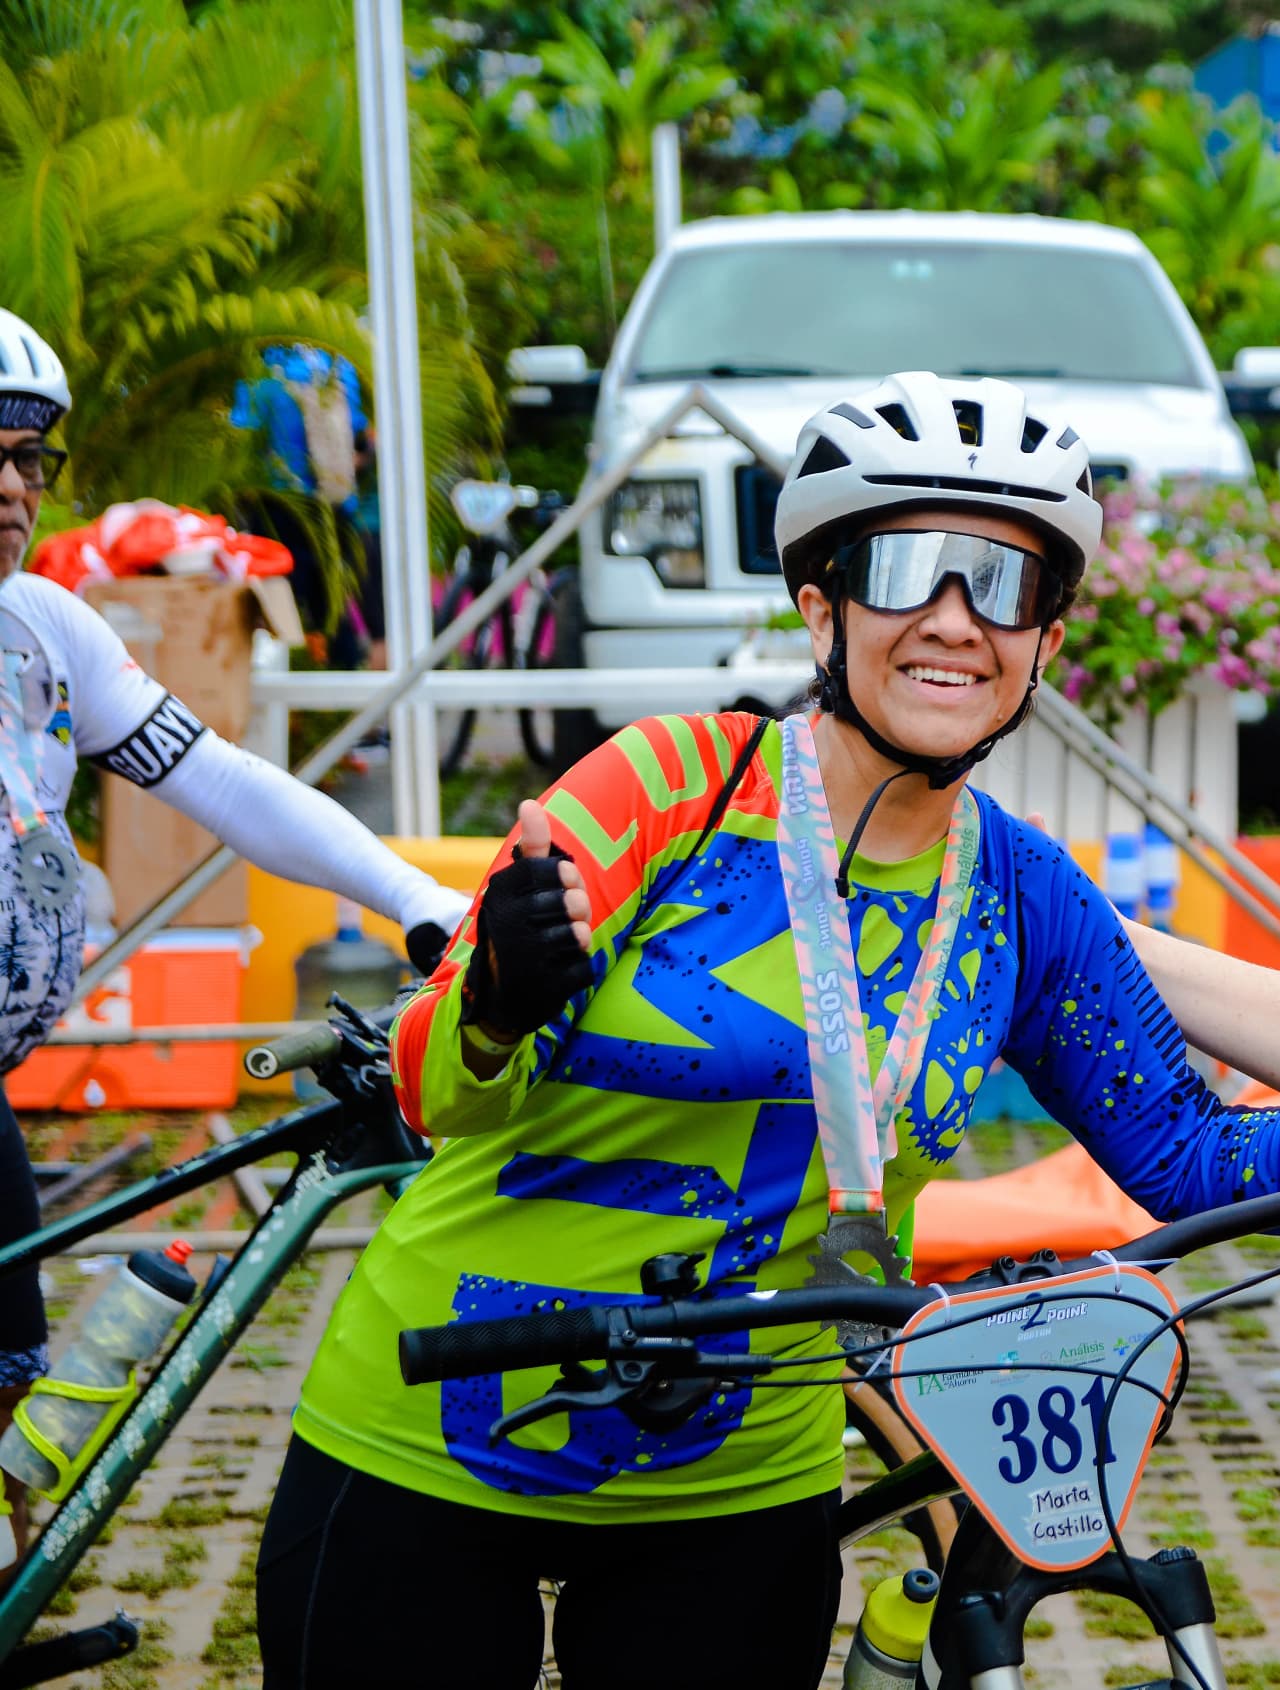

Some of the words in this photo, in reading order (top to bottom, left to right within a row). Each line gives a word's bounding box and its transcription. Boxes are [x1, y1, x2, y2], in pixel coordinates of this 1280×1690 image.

[106, 695, 204, 786] GUAY
[1047, 1302, 1088, 1323] POINT
[1059, 1341, 1105, 1360] Análisis
[991, 1374, 1117, 1484] 381
[1033, 1515, 1104, 1540] Castillo
